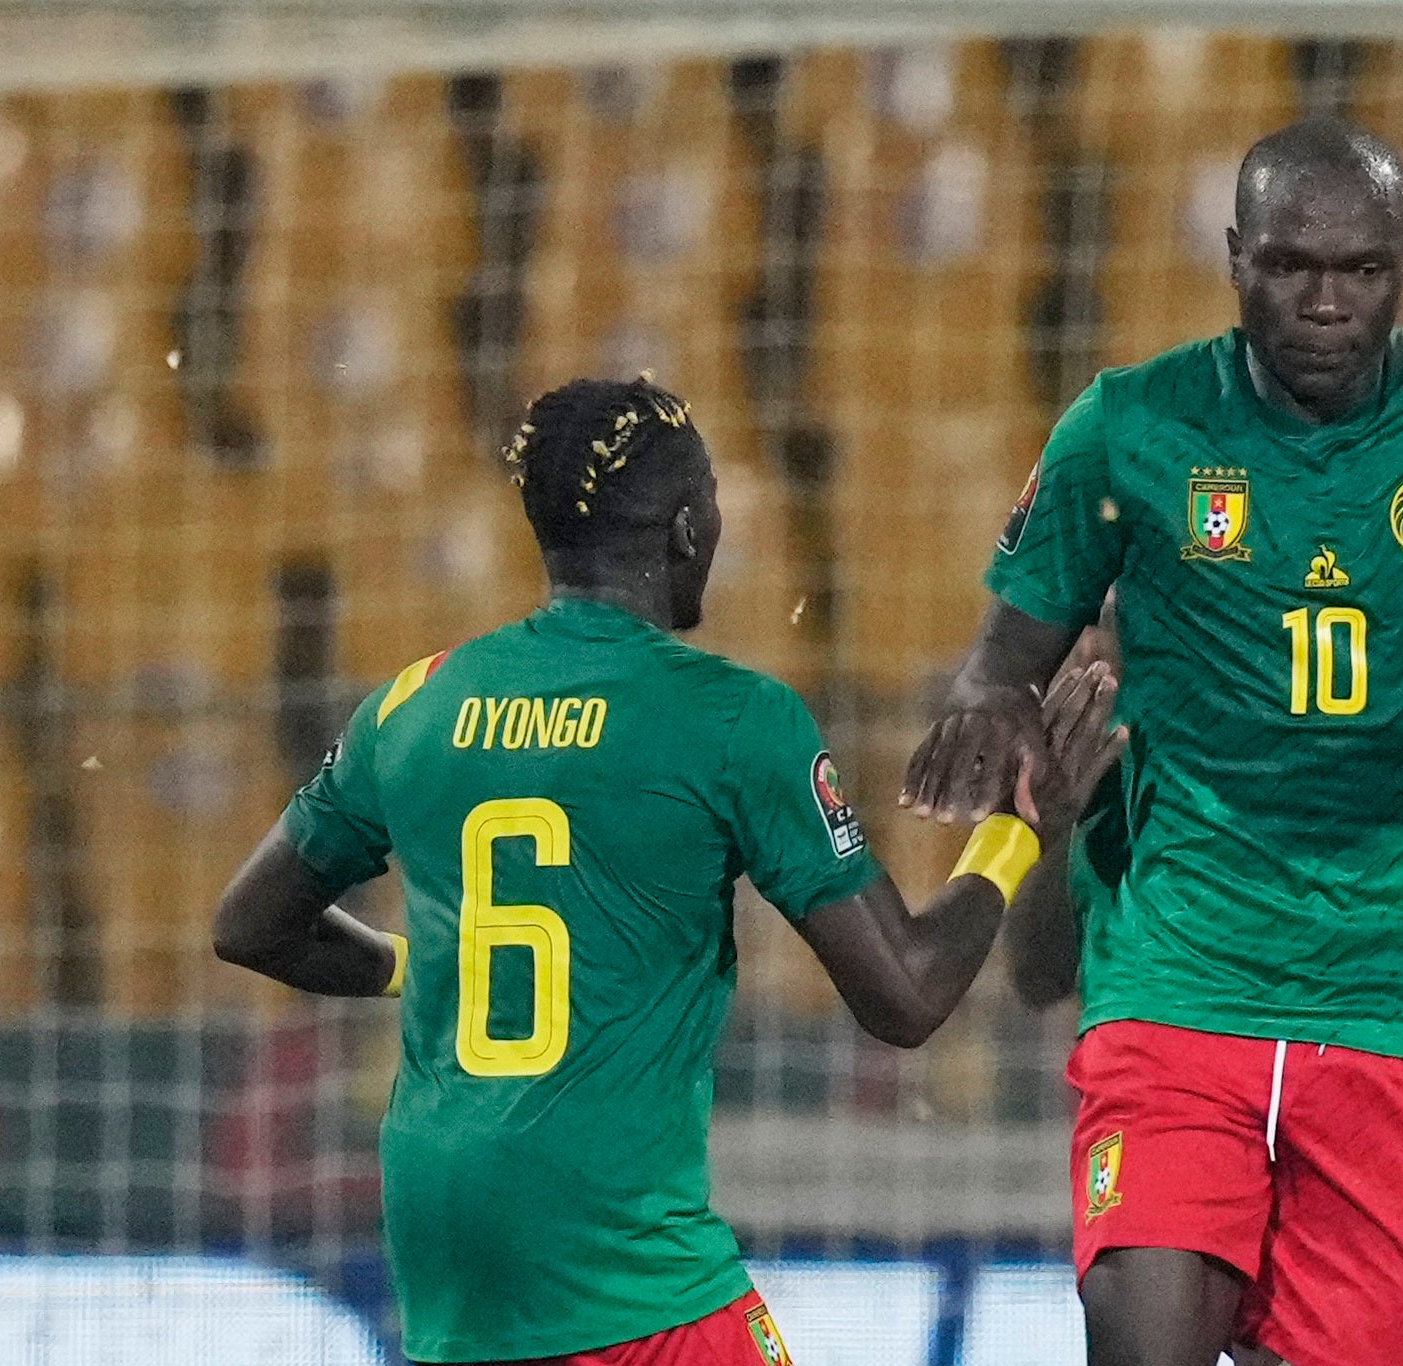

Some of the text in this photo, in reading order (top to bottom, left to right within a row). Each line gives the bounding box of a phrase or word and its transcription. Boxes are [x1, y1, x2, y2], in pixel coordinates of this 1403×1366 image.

[1282, 606, 1367, 715] 10
[452, 697, 607, 750] OYONGO
[456, 797, 571, 1077] 6
